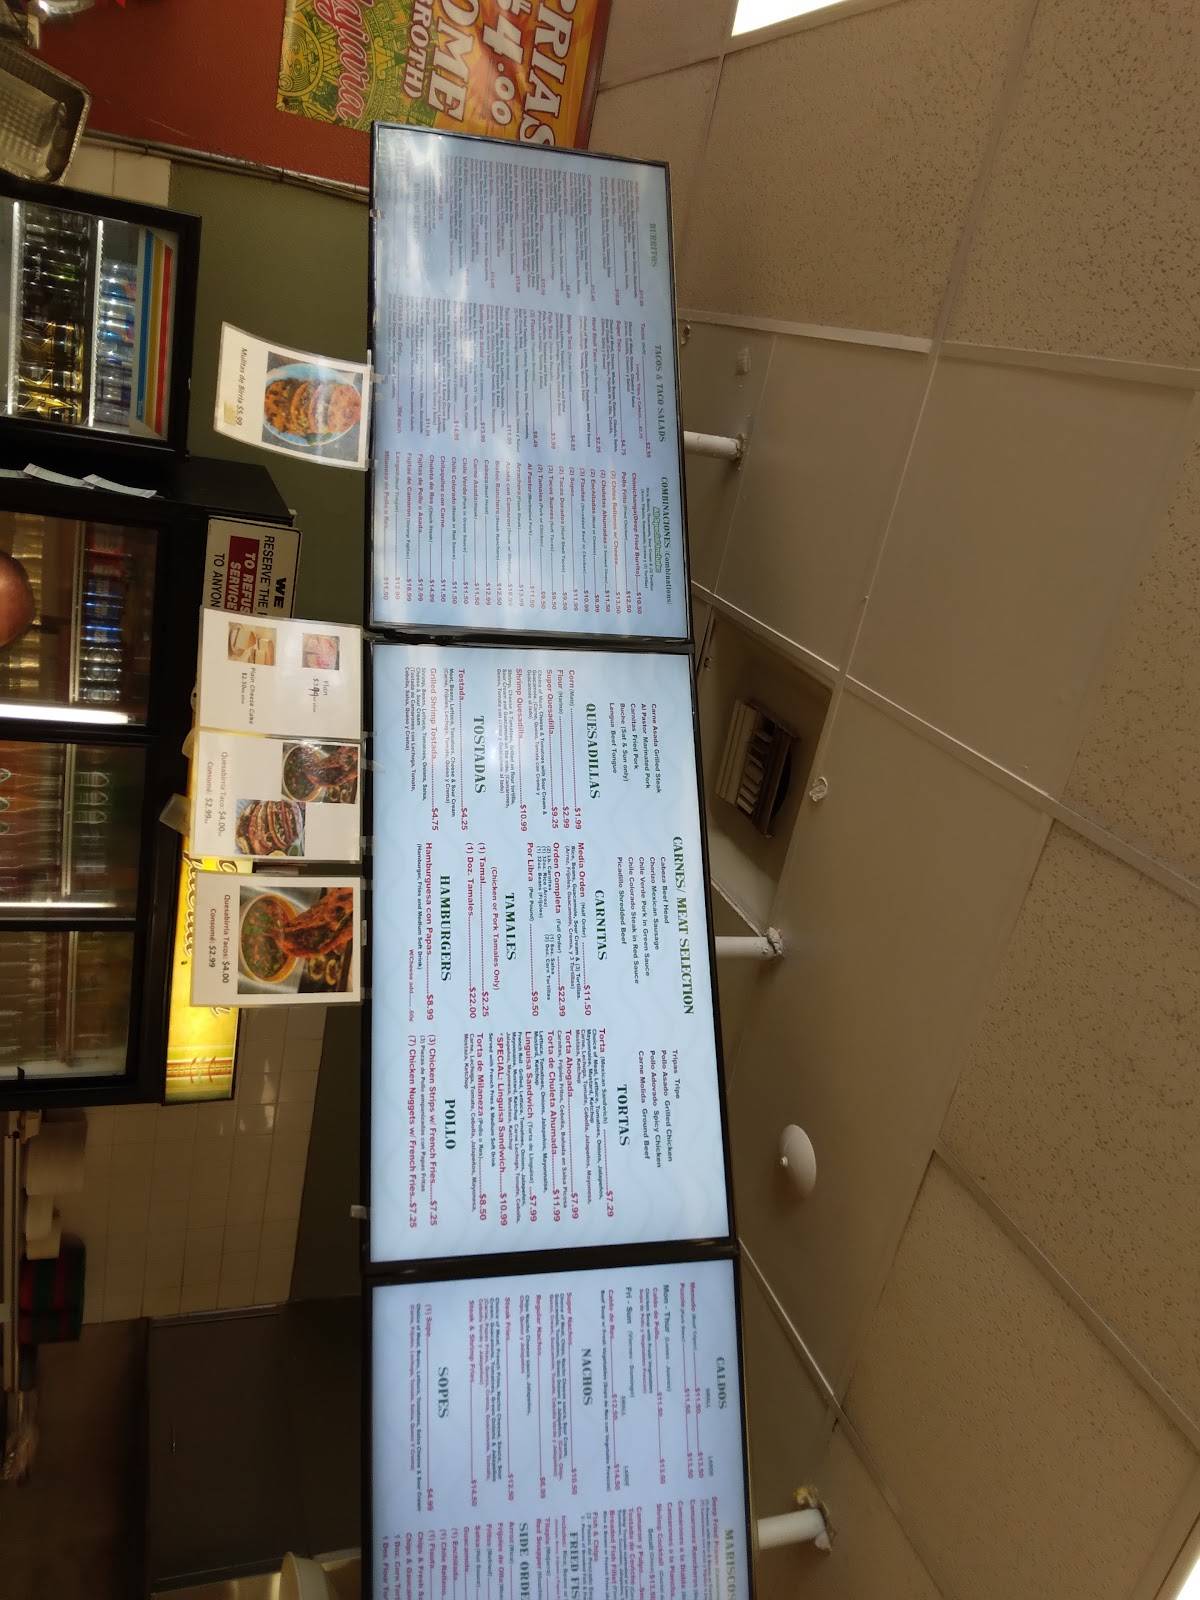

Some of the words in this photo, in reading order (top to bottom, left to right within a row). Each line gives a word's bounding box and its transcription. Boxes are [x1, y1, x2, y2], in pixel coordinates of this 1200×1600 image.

[403, 0, 434, 98] ROTH)
[240, 375, 246, 383] de
[236, 405, 244, 426] $5.99
[661, 477, 671, 548] COMBINACIONES
[214, 553, 225, 566] TO
[244, 553, 256, 569] TO
[261, 536, 274, 584] RESERVE
[227, 562, 241, 610] SERVICE
[258, 589, 269, 608] THE
[274, 578, 286, 608] WE
[608, 702, 616, 728] Lengua
[642, 704, 647, 712] Al
[473, 716, 486, 794] TOSTADAS
[586, 703, 600, 799] QUESADILLAS
[478, 842, 486, 854] (1)
[672, 836, 686, 892] CARNES/
[424, 842, 432, 904] Hamburguesa
[440, 876, 451, 981] HAMBURGERS
[505, 892, 516, 960] TAMALES
[594, 890, 608, 960] CARNITAS
[676, 897, 688, 934] MEAT
[222, 937, 230, 959] Tacos:
[425, 928, 433, 955] Papas
[222, 961, 230, 983] $4.00
[679, 938, 694, 1015] SELECTION
[408, 1035, 416, 1046] (7)
[564, 1030, 572, 1054] Torta
[566, 1057, 574, 1097] Ahogada
[671, 1050, 679, 1074] Tripas
[407, 1088, 416, 1124] Nuggets
[445, 1099, 456, 1150] POLLO
[617, 1084, 630, 1146] TORTAS
[652, 1110, 660, 1132] Spicy
[664, 1100, 672, 1126] Grilled
[409, 1127, 416, 1138] w/
[438, 1367, 449, 1418] SOPES
[582, 1349, 592, 1406] NACHOS
[716, 1357, 726, 1409] CALDOS
[519, 1522, 528, 1556] SIDE
[570, 1532, 578, 1571] FRIED
[724, 1529, 736, 1600] MARISCOS
